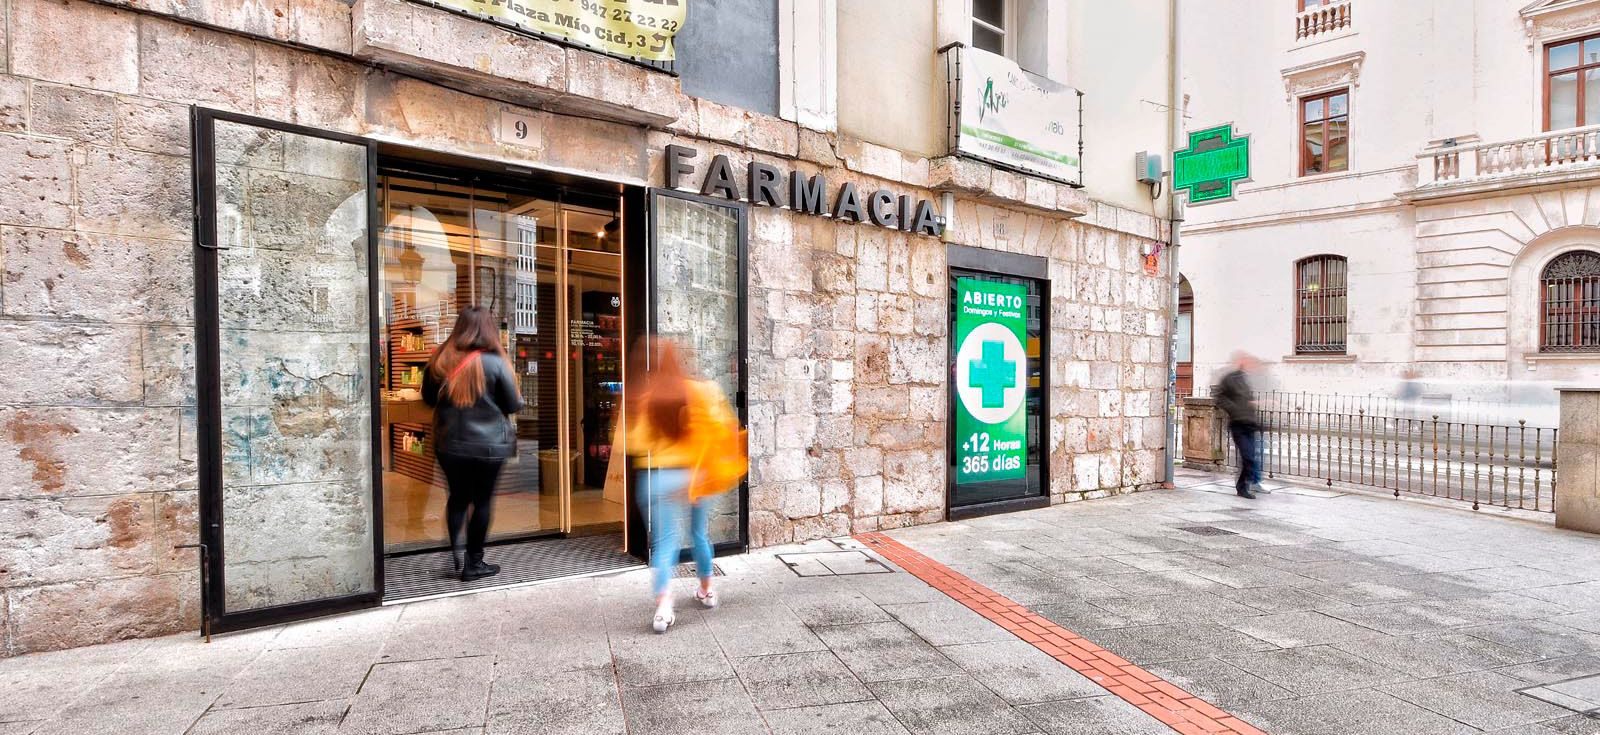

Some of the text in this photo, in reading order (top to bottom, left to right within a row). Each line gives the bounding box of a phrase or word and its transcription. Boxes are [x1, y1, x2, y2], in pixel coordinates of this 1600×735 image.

[581, 0, 607, 18] 947
[613, 8, 632, 23] 27
[637, 14, 656, 28] 22
[661, 18, 678, 33] 22
[594, 26, 633, 49] Cid,
[636, 34, 647, 48] 3
[515, 120, 528, 140] 9
[664, 143, 942, 236] FARMACIA
[963, 290, 1022, 309] ABIERTO
[963, 305, 993, 317] Domingos
[994, 310, 998, 318] y
[962, 453, 1021, 474] 365 días
